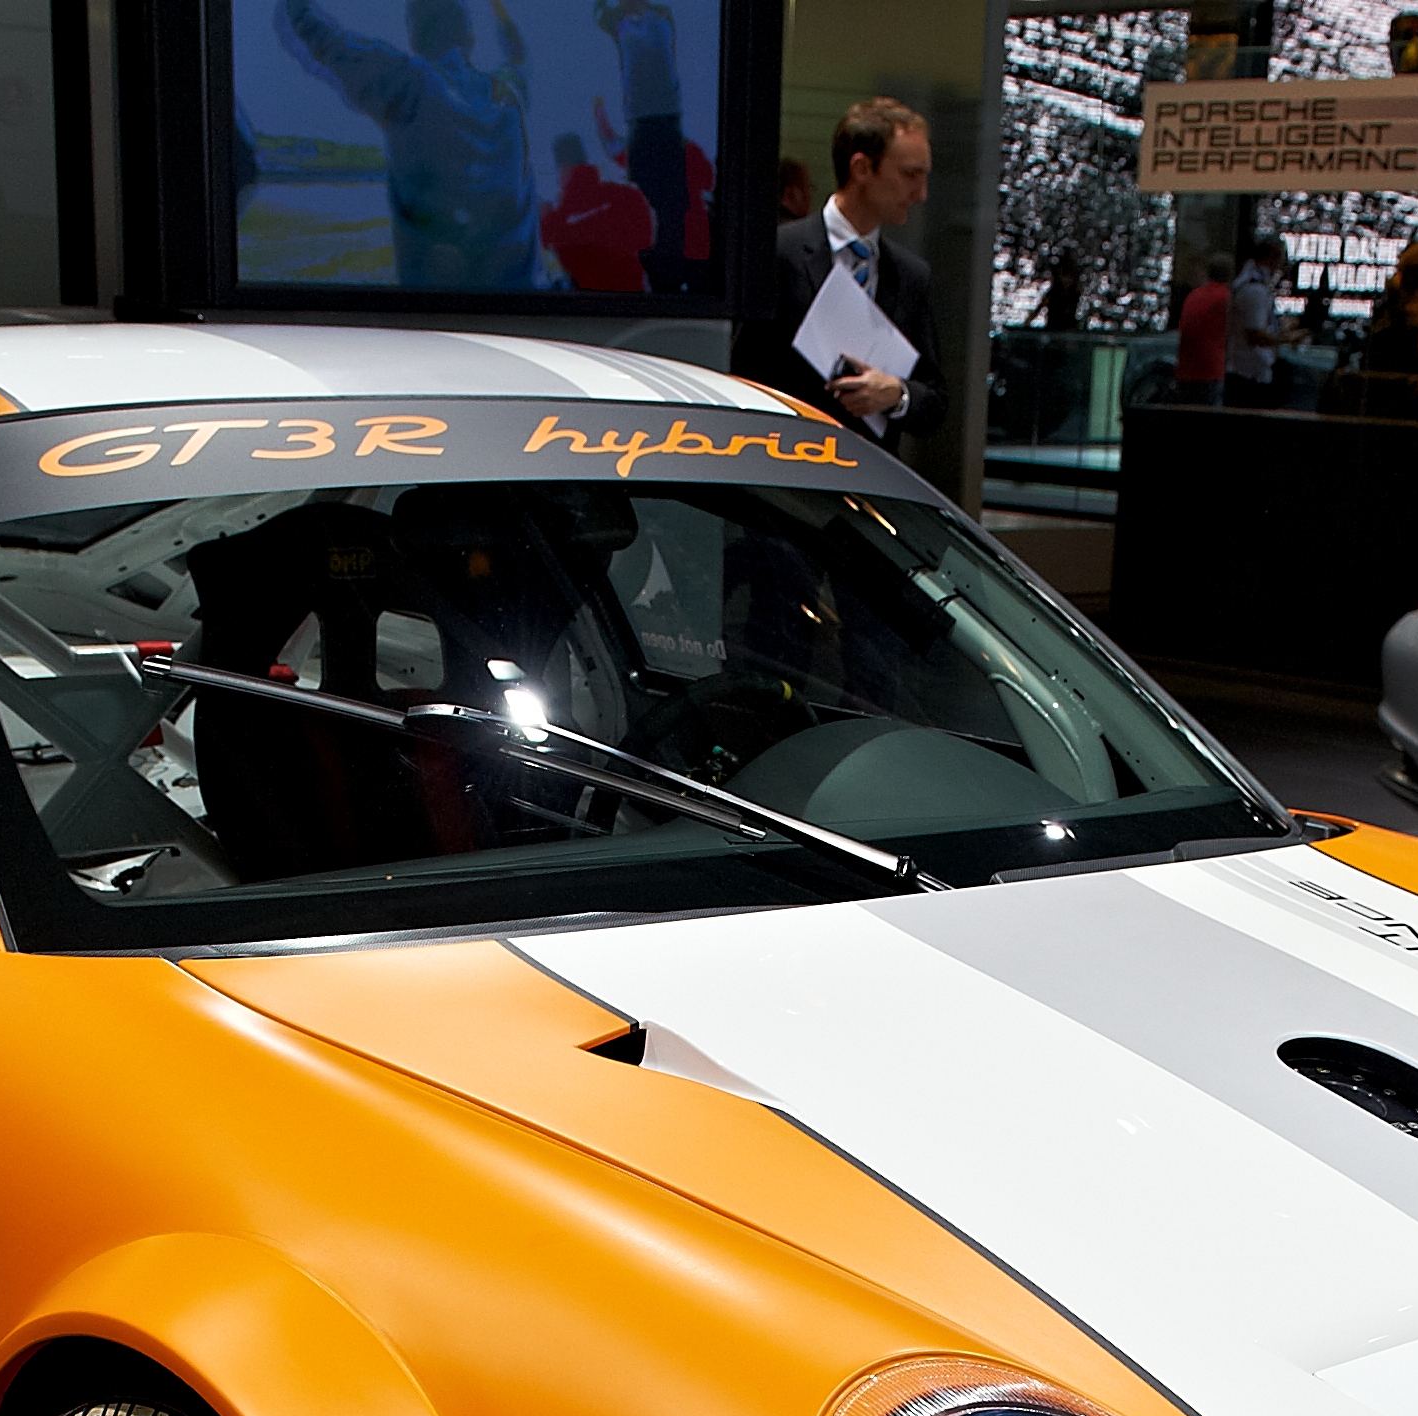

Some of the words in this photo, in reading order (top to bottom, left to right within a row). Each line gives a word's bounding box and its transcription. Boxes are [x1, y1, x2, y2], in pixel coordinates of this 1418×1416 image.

[1155, 98, 1337, 123] PORSCHE
[1153, 122, 1392, 148] INTELLIGENT
[523, 414, 860, 478] hybrid
